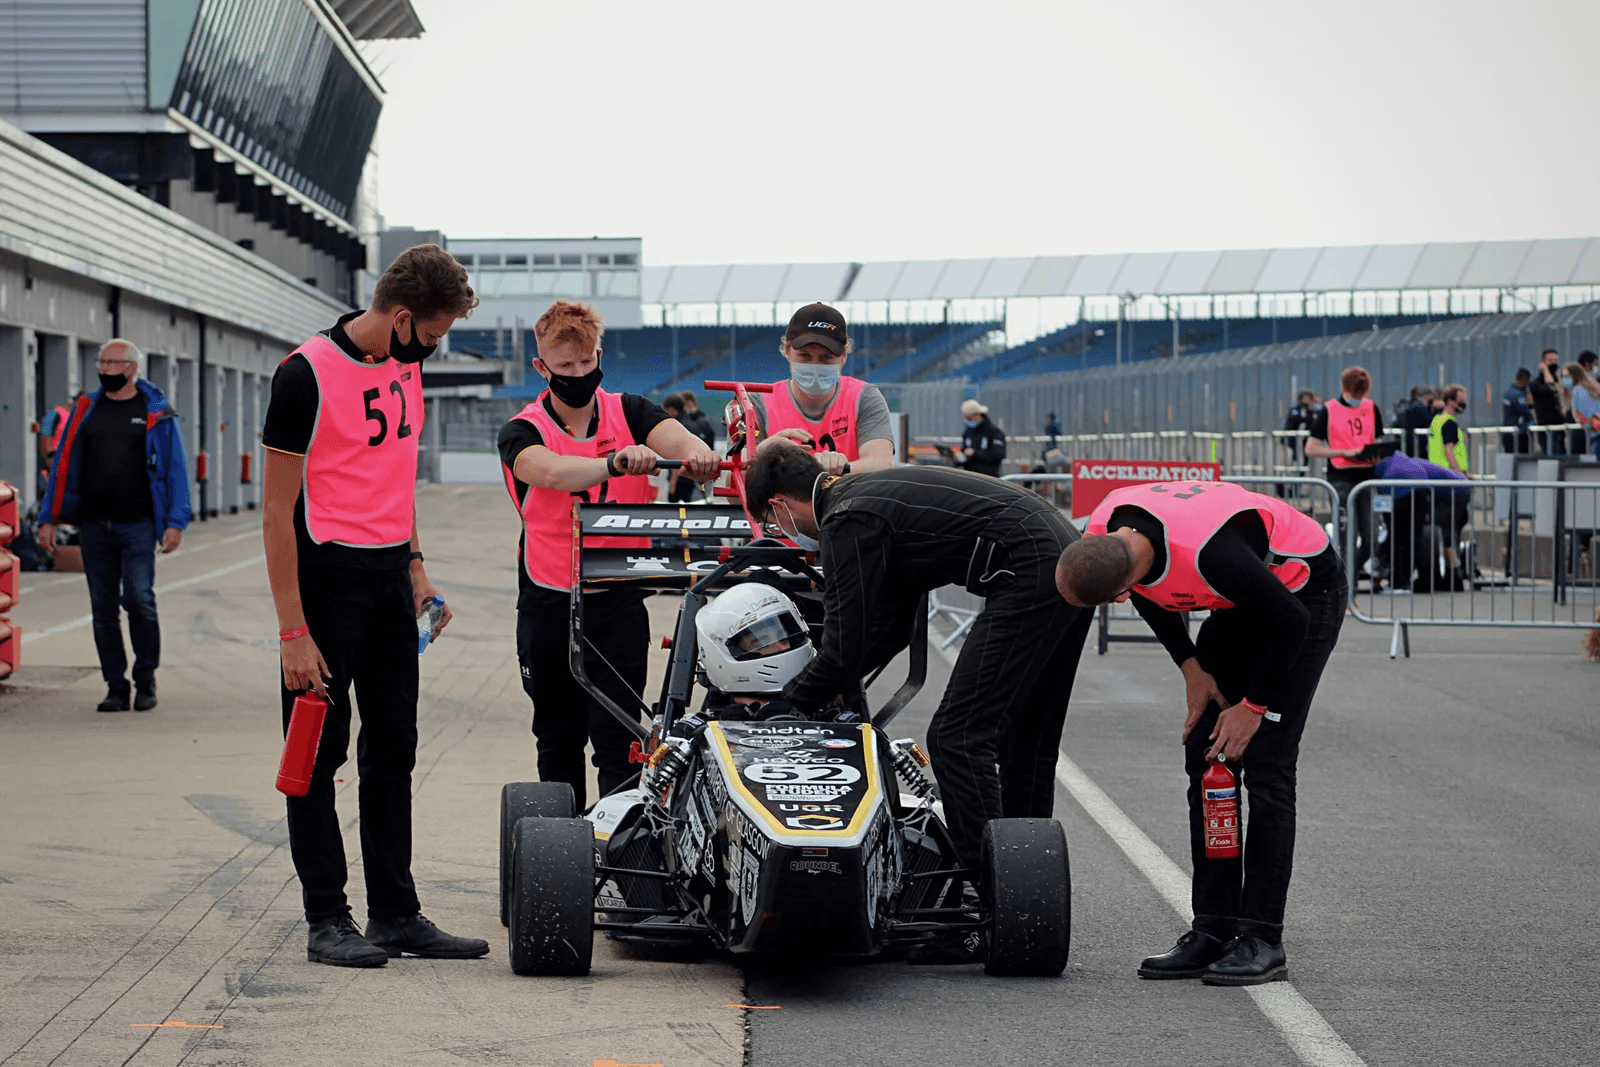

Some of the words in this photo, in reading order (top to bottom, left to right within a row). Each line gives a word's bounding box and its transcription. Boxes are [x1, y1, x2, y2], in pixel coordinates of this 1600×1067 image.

[807, 320, 838, 331] UGR
[362, 380, 412, 447] 52
[1347, 417, 1363, 437] 19
[1077, 465, 1215, 481] ACCELERATION
[747, 726, 835, 735] midton
[760, 766, 848, 782] 52
[779, 803, 845, 812] UGR
[736, 811, 770, 860] GLASGOW
[790, 860, 843, 875] ROUNDEL
